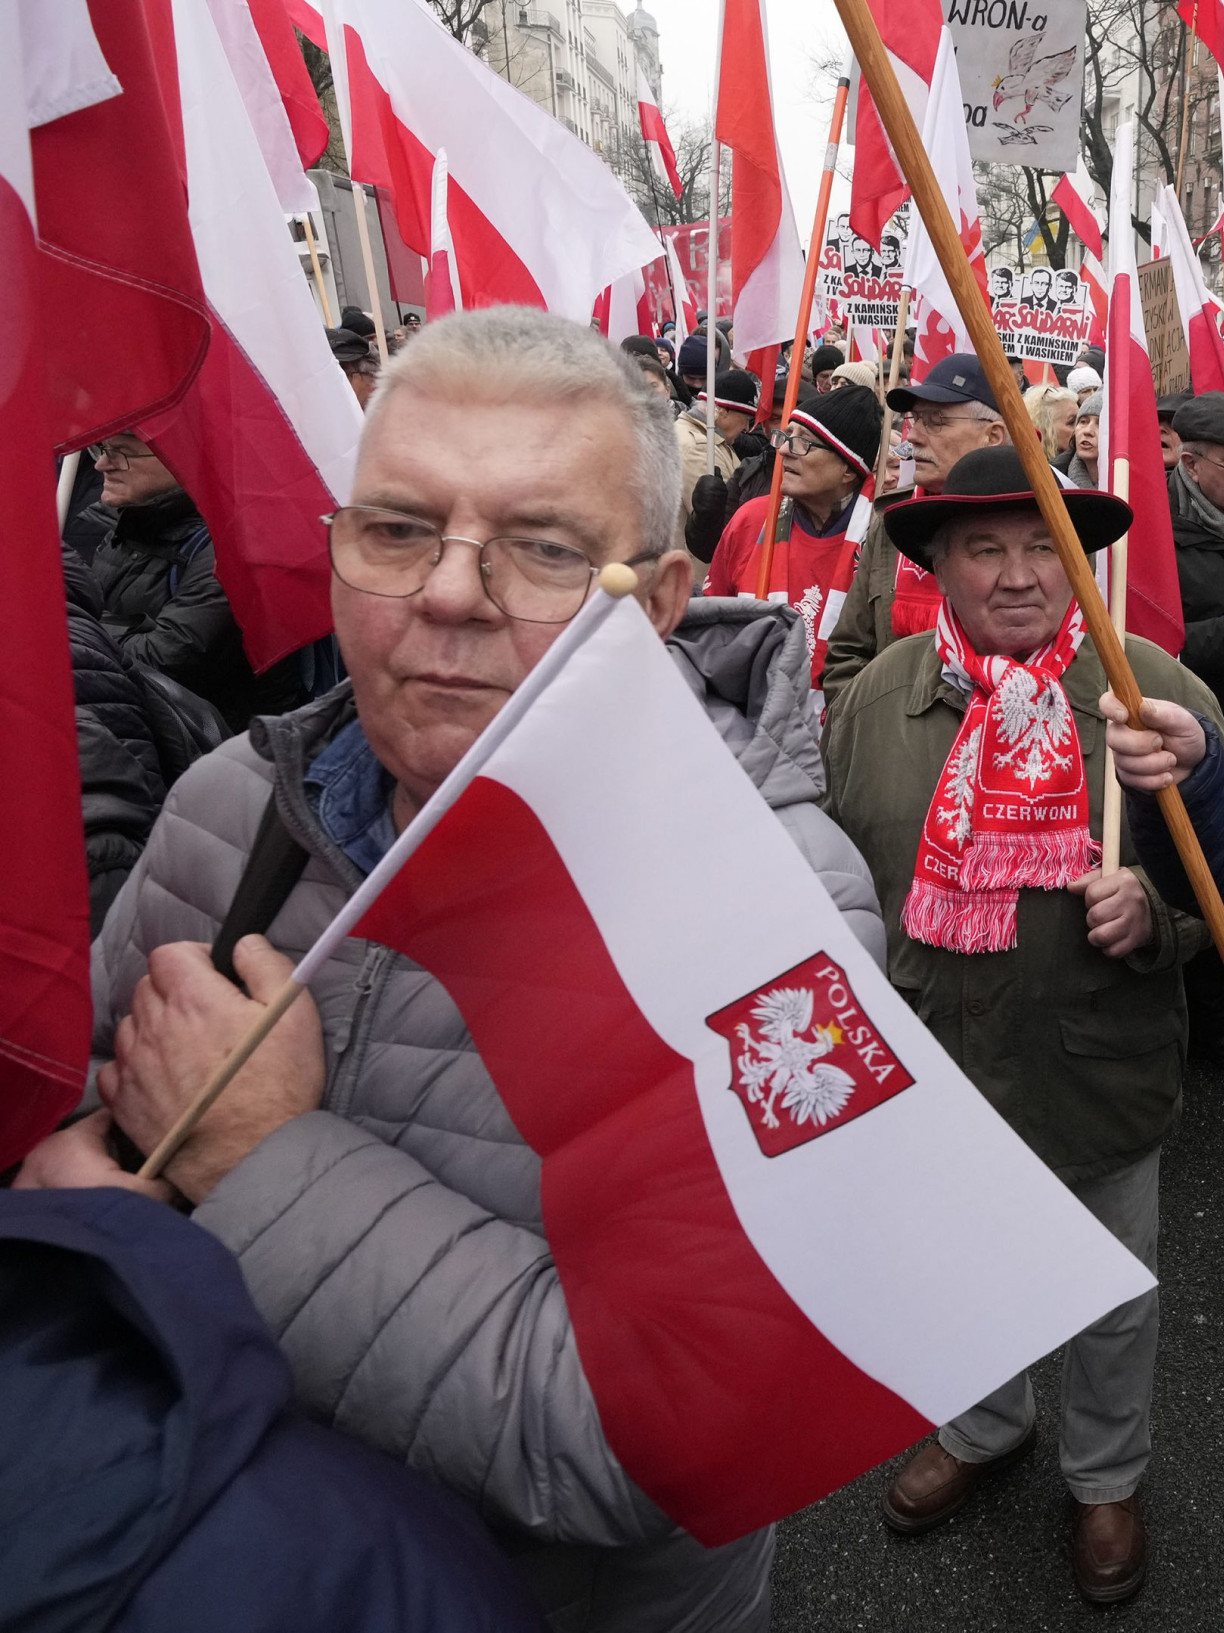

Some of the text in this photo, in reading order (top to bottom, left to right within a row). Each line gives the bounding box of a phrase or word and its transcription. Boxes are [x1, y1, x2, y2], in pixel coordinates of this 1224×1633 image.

[856, 315, 898, 326] WĄSIKIE
[1017, 334, 1022, 344] Z
[1024, 334, 1079, 352] KAMIŃSKIM
[1025, 345, 1074, 362] WĄSIKIEM
[983, 803, 1078, 821] CZERWONI
[815, 965, 896, 1085] POLSKA
